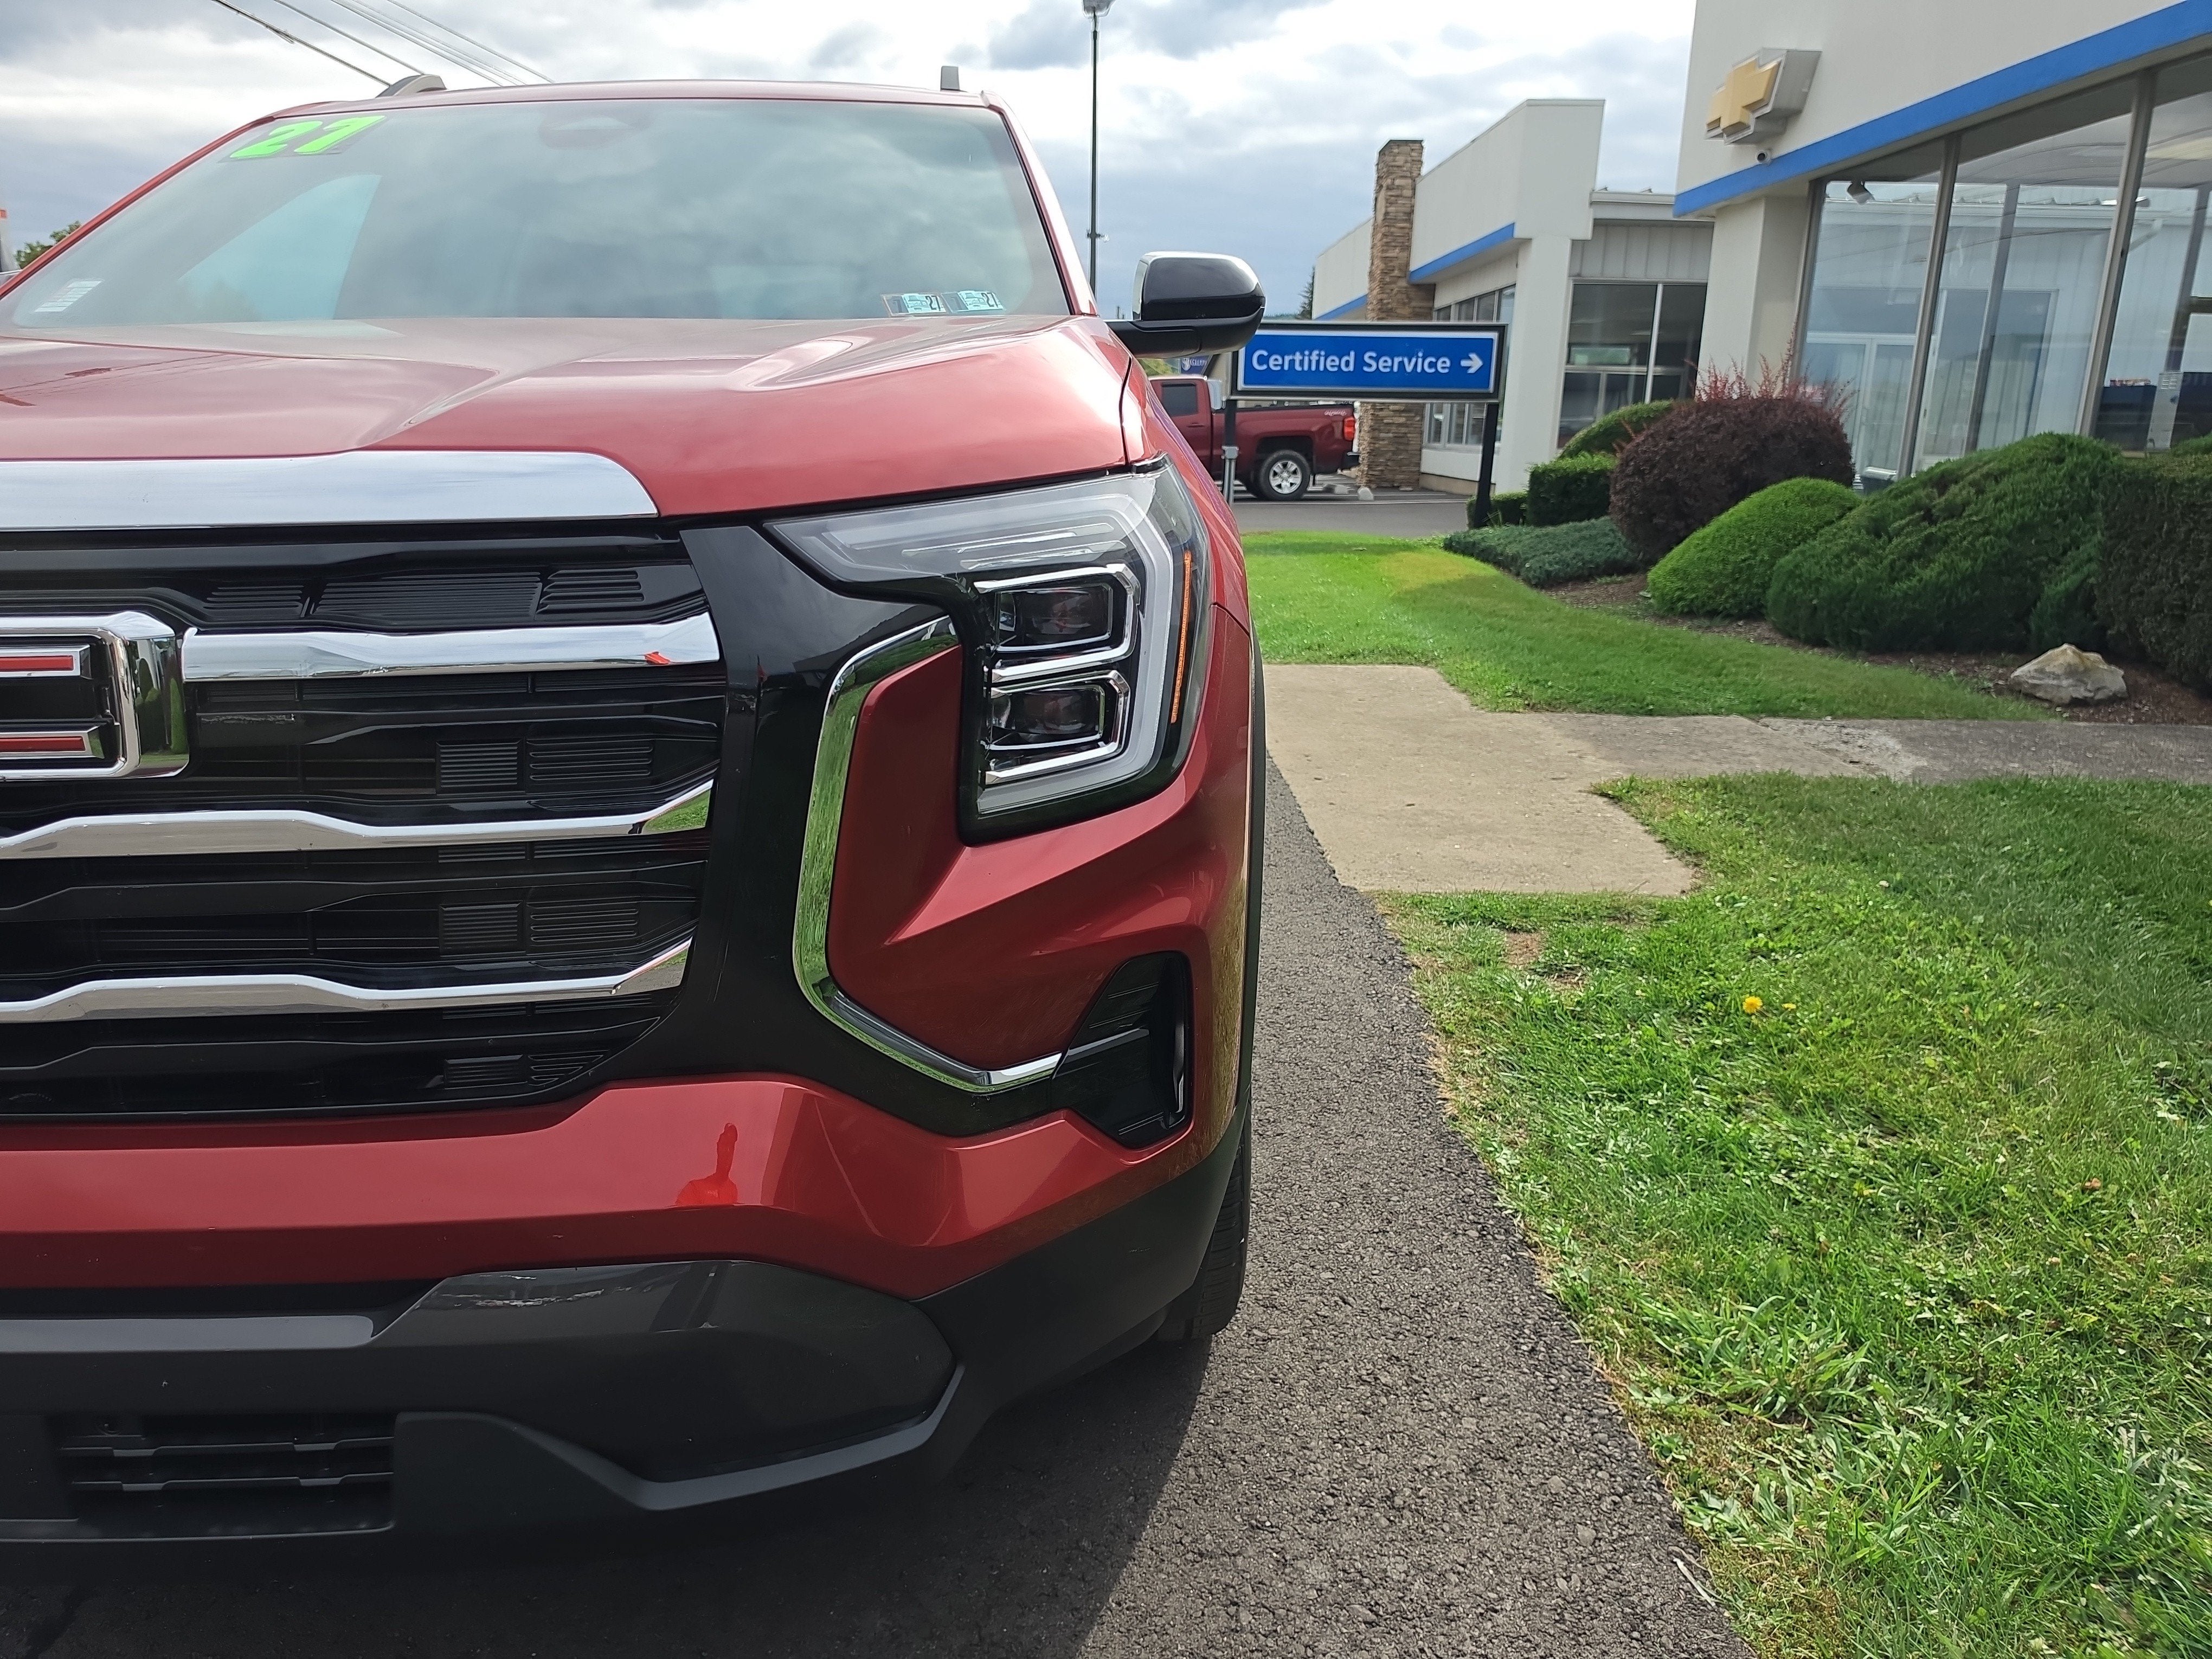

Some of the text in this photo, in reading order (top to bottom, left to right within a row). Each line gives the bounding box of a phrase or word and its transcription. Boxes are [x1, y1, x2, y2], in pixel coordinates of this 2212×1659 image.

[924, 295, 941, 311] 27
[981, 292, 999, 308] 27
[1252, 349, 1451, 374] Certified Service
